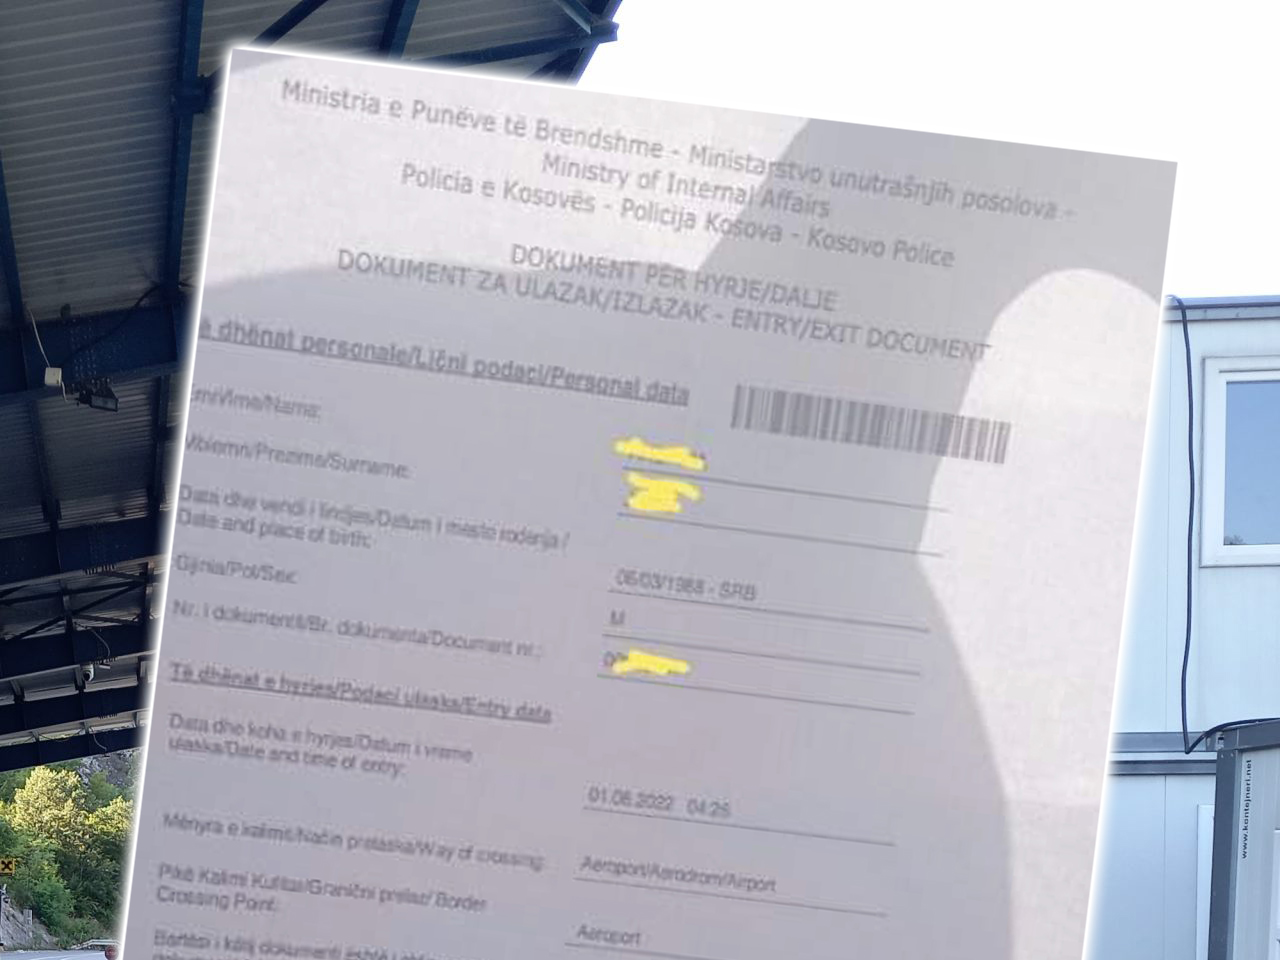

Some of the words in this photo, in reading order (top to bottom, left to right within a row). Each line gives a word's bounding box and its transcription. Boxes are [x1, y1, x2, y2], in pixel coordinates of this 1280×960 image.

[280, 78, 381, 115] Ministria
[387, 99, 403, 118] e
[411, 99, 497, 132] Punëve
[503, 113, 527, 137] të
[534, 118, 664, 159] Brendshme
[688, 143, 824, 185] Ministarstvo
[828, 163, 955, 207] unutrašnjih
[400, 162, 474, 194] Policia
[480, 179, 495, 198] e
[502, 179, 596, 214] Kosovës
[619, 197, 697, 232] Policija
[702, 210, 783, 243] Kosova
[806, 226, 886, 258] Kosovo
[891, 238, 956, 268] Police
[541, 152, 631, 188] Ministry
[635, 166, 661, 192] of
[665, 172, 754, 206] Internal
[758, 185, 831, 219] Affairs
[335, 248, 471, 288] DOKUMENT
[475, 268, 509, 294] ZA
[513, 273, 709, 325] ULAZAK/IZLAZAK
[731, 306, 862, 346] ENTRY/EXIT
[865, 326, 992, 364] DOCUMENT
[509, 242, 637, 283] DOKUMENT
[691, 270, 837, 312] HYRJE/DALJE
[644, 380, 690, 405] data
[176, 507, 219, 530] Date
[221, 513, 256, 534] and
[258, 521, 305, 542] place
